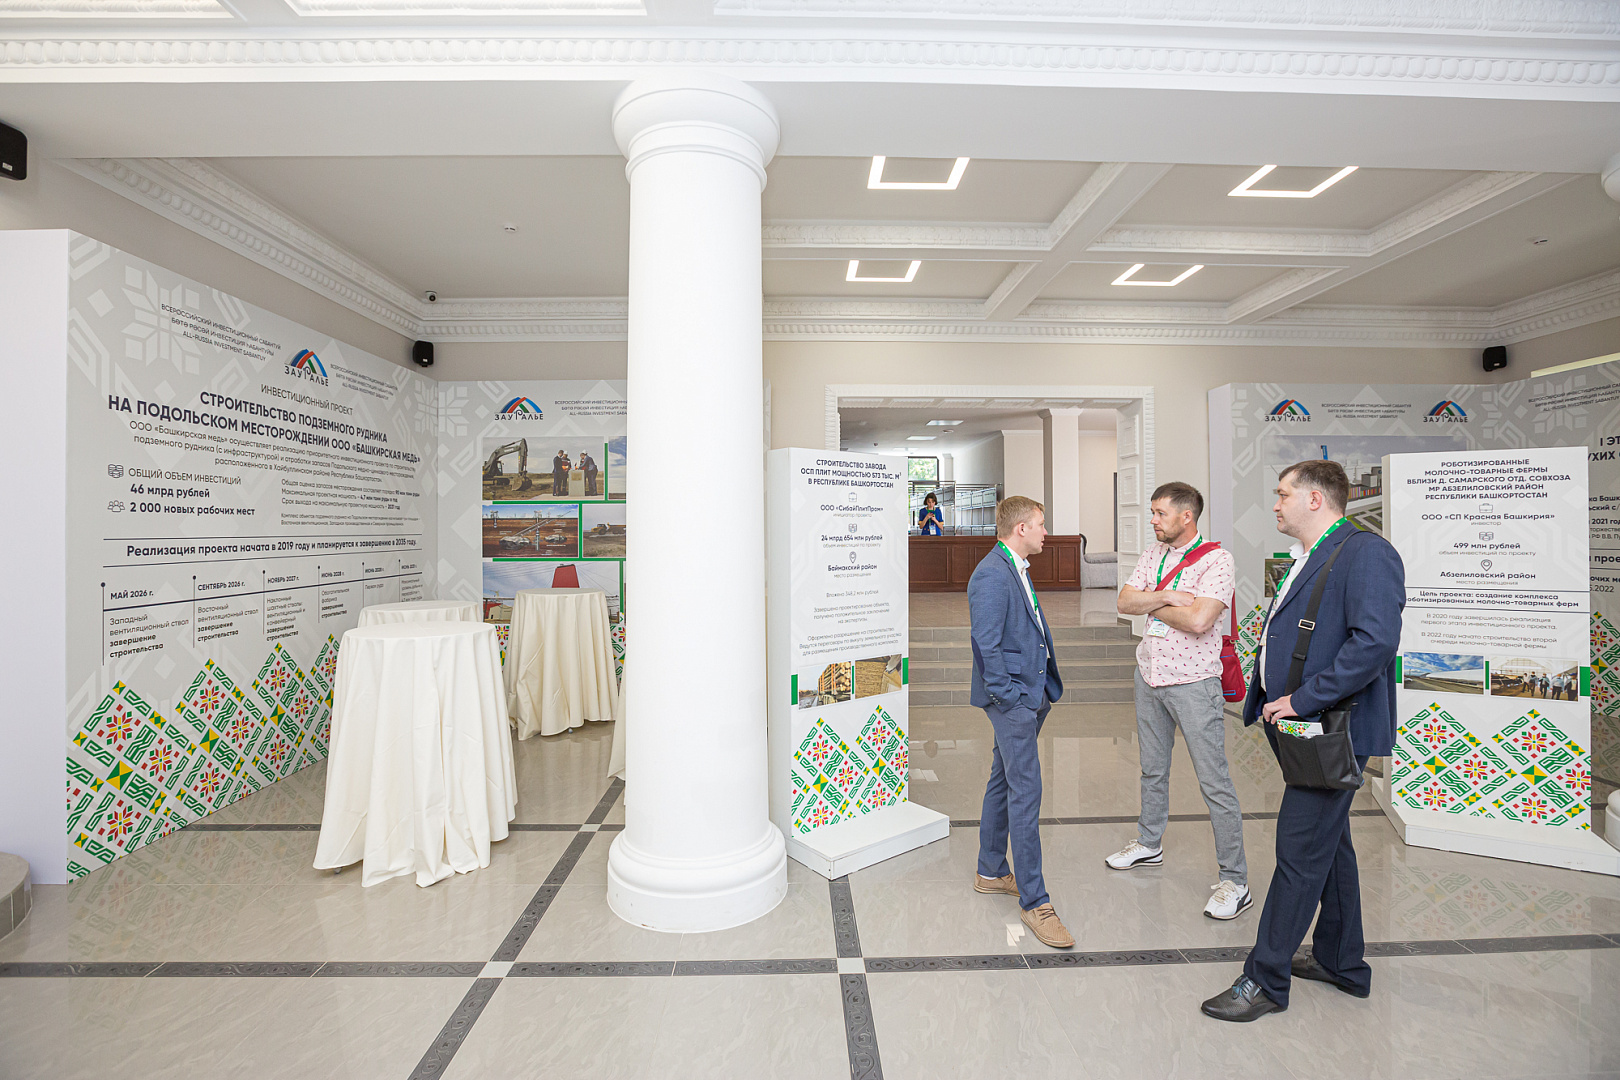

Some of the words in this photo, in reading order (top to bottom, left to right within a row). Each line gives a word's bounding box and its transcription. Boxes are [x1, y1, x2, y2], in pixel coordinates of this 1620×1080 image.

[183, 331, 212, 344] ALL-RUSSIA
[214, 340, 242, 353] INVESTMENT
[284, 366, 328, 386] ЗАУРАЛЬЕ
[261, 384, 329, 409] ИНВЕСТИЦИОННЫЙ
[330, 402, 353, 415] ПРОЕКТ
[200, 391, 296, 422] СТРОИТЕЛЬСТВО
[298, 413, 354, 435] ПОДЗЕМНОГО
[356, 427, 387, 442] РУДНИКА
[495, 410, 543, 420] ЗАУРАЛЬЕ
[1265, 411, 1311, 422] ЗАУРАЛЬЕ
[1423, 412, 1468, 423] ЗАУРАЛЬЕ
[108, 394, 132, 412] НА
[137, 400, 237, 431] ПОДОЛЬСКОМ
[241, 420, 329, 447] МЕСТОРОЖДЕНИИ
[331, 438, 350, 450] ООО
[352, 443, 400, 459] «БАШКИРСКАЯ
[402, 452, 420, 463] МЕДЬ»
[816, 459, 864, 468] СТРОИТЕЛЬСТВО
[1441, 459, 1529, 467] РОБОТИЗИРОВАННЫЕ
[128, 468, 162, 478] ОБЩИЙ
[164, 471, 192, 481] ОБЪЕМ
[194, 474, 241, 485] ИНВЕСТИЦИЙ
[130, 483, 144, 494] 46
[147, 487, 173, 497] млрд
[176, 487, 209, 498] рублей
[130, 502, 136, 512] 2
[140, 502, 161, 512] 000
[197, 505, 234, 516] рабочих
[127, 545, 195, 556] Реализация
[198, 545, 237, 556] проекта
[277, 541, 293, 550] 2019
[317, 541, 354, 549] планируется
[197, 582, 227, 590] СЕНТЯБРЬ
[110, 590, 128, 599] МАЙ
[130, 589, 147, 597] 2026
[198, 604, 228, 613] Восточный
[110, 614, 147, 625] Западный
[198, 610, 243, 622] вентиляционный
[110, 621, 169, 636] вентиляционный
[198, 622, 233, 632] завершение
[110, 634, 156, 647] завершение
[197, 630, 238, 642] строительства
[109, 643, 163, 658] строительства
